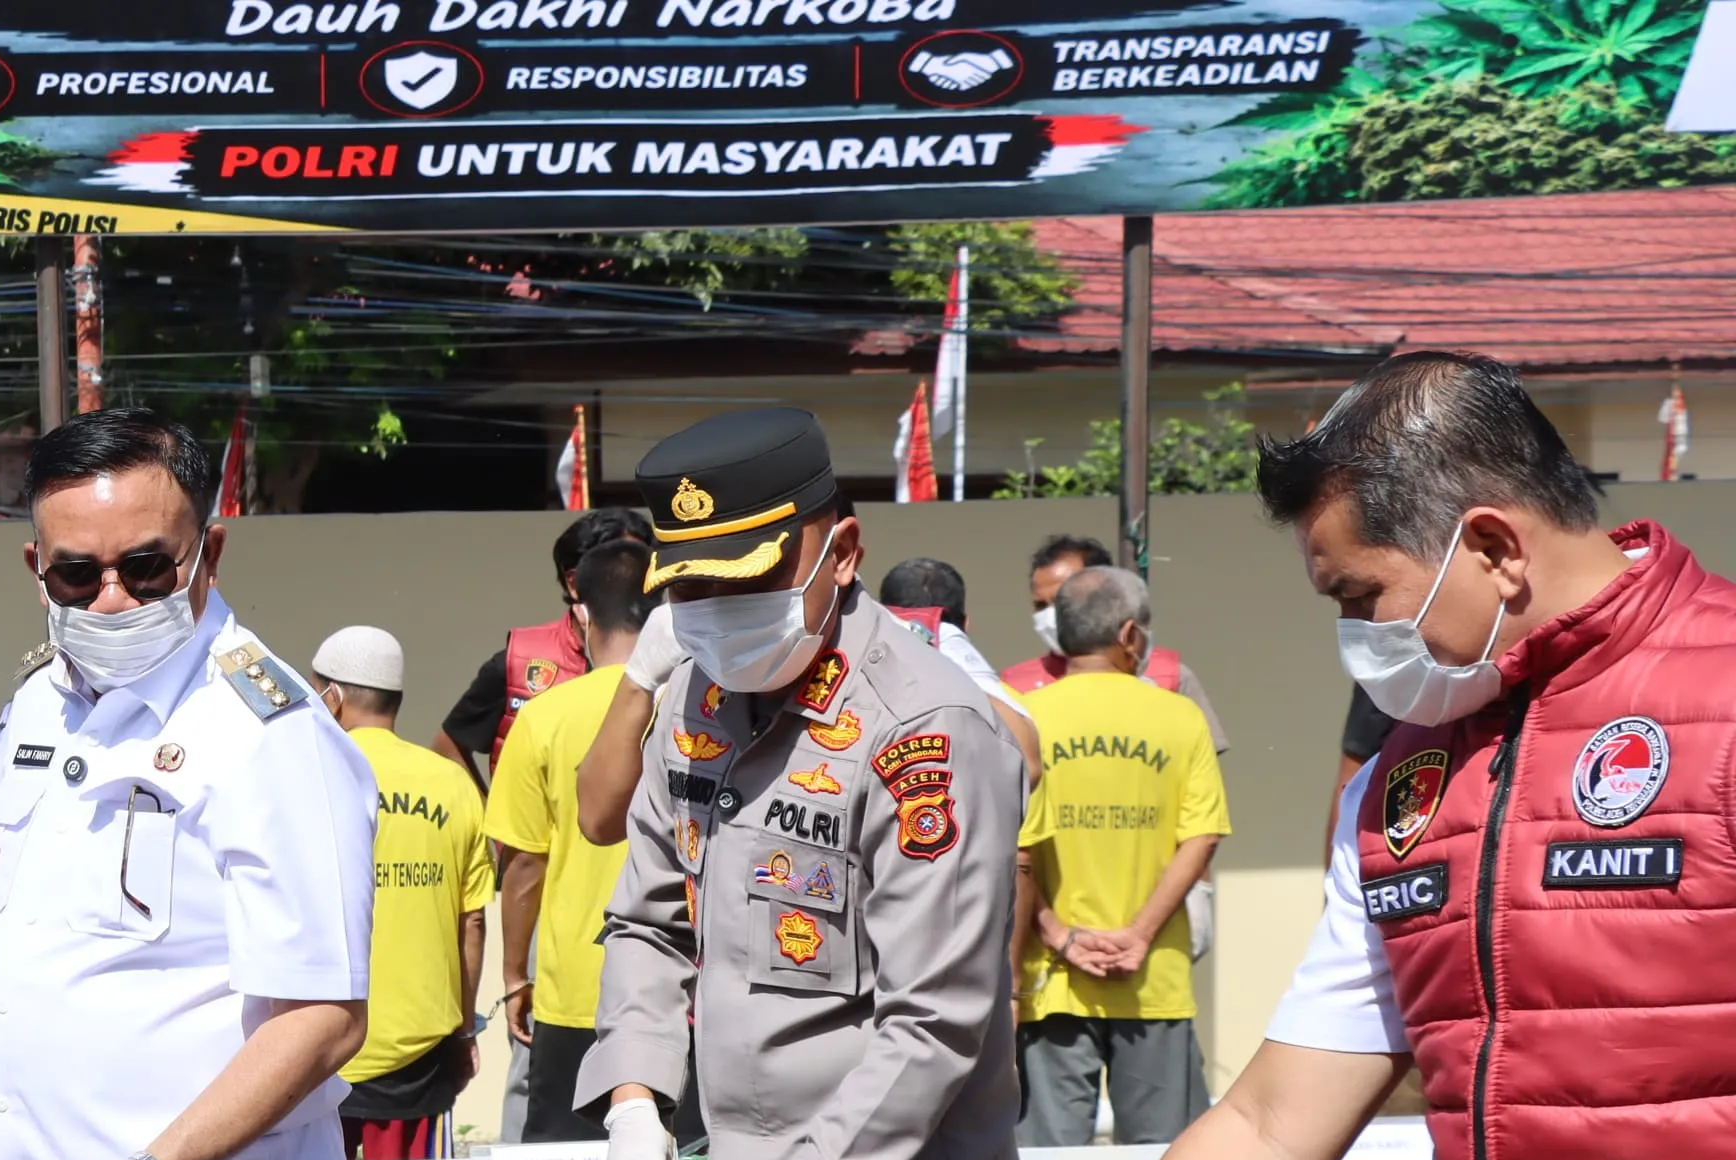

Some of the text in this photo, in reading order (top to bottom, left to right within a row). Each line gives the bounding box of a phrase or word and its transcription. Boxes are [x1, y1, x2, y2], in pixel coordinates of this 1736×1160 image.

[1053, 31, 1330, 62] TRANSPARANSI
[36, 70, 275, 96] PROFESIONAL
[506, 65, 808, 91] RESPONSIBILITAS
[1053, 59, 1319, 91] BERKEADILAN
[221, 132, 1014, 178] POLRI UNTUK MASYARAKAT
[37, 210, 117, 234] POLISI
[878, 737, 943, 768] POLRES
[1393, 754, 1443, 779] RESERSE
[899, 772, 939, 790] ACEH
[764, 798, 841, 848] POLRI
[1551, 847, 1654, 877] KANIT
[1364, 875, 1434, 916] ERIC
